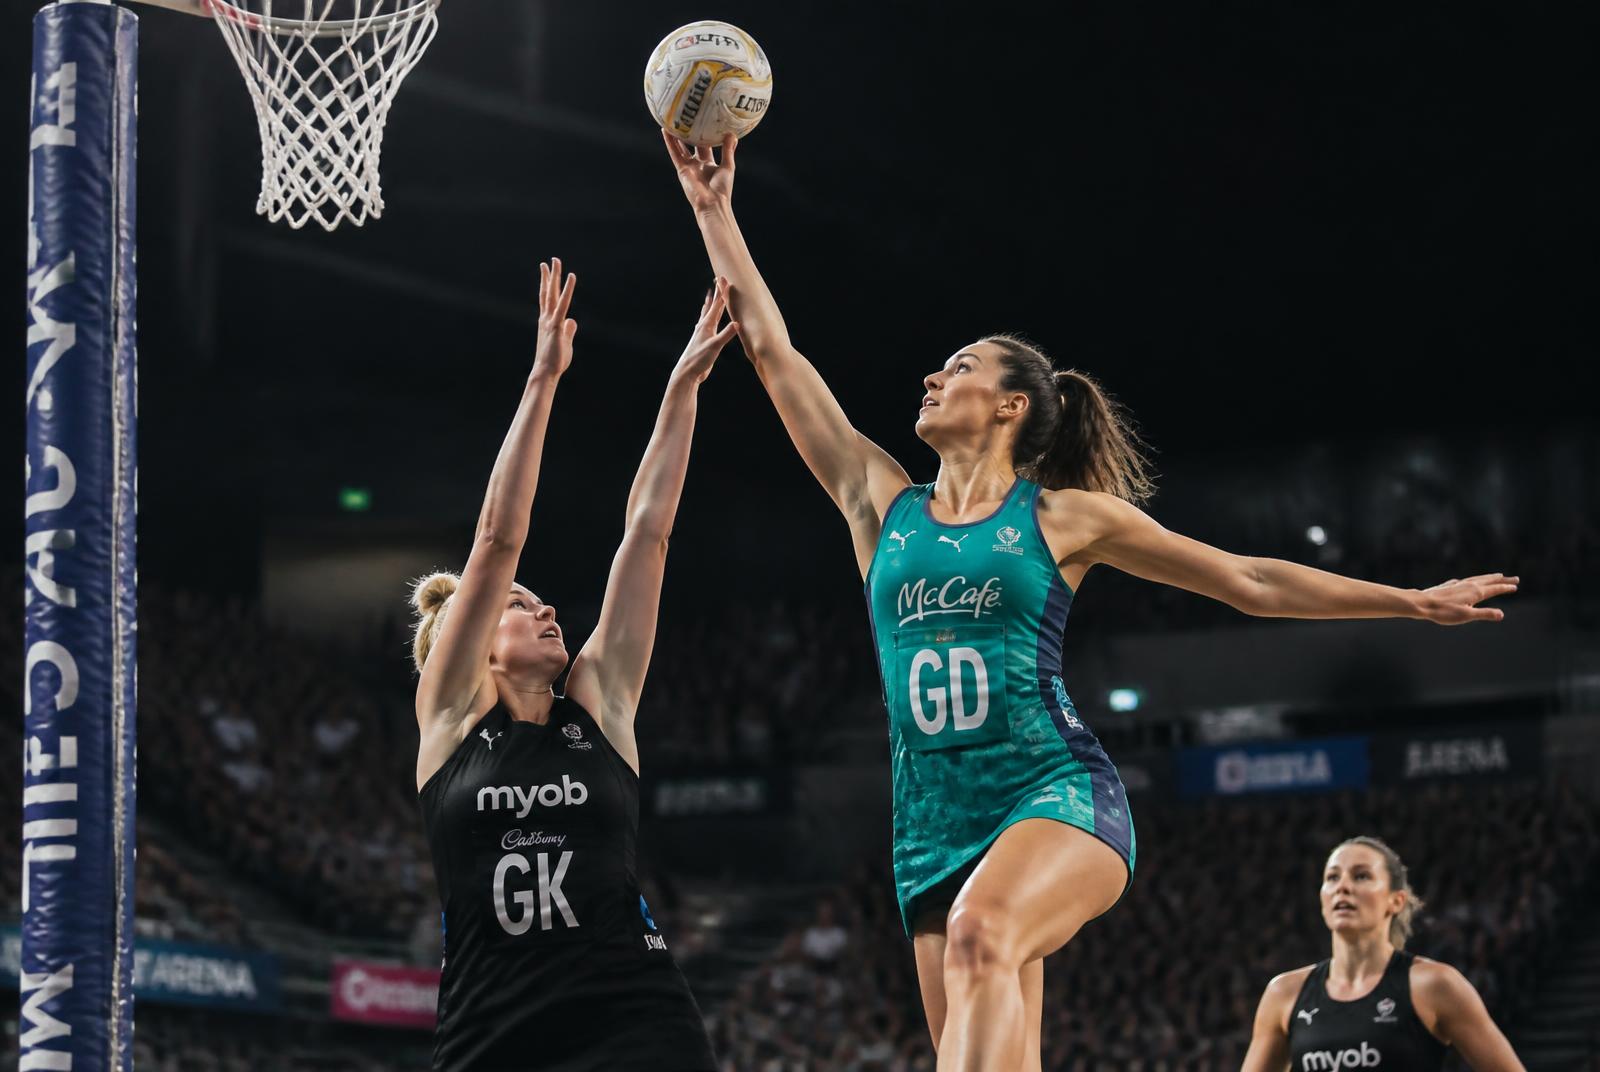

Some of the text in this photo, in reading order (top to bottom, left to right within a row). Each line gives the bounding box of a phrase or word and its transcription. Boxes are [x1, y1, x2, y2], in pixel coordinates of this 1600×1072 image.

[897, 575, 1002, 621] McCafé
[908, 646, 990, 736] GD
[476, 774, 589, 819] myob
[492, 850, 580, 936] GK
[1302, 1041, 1381, 1072] myob
